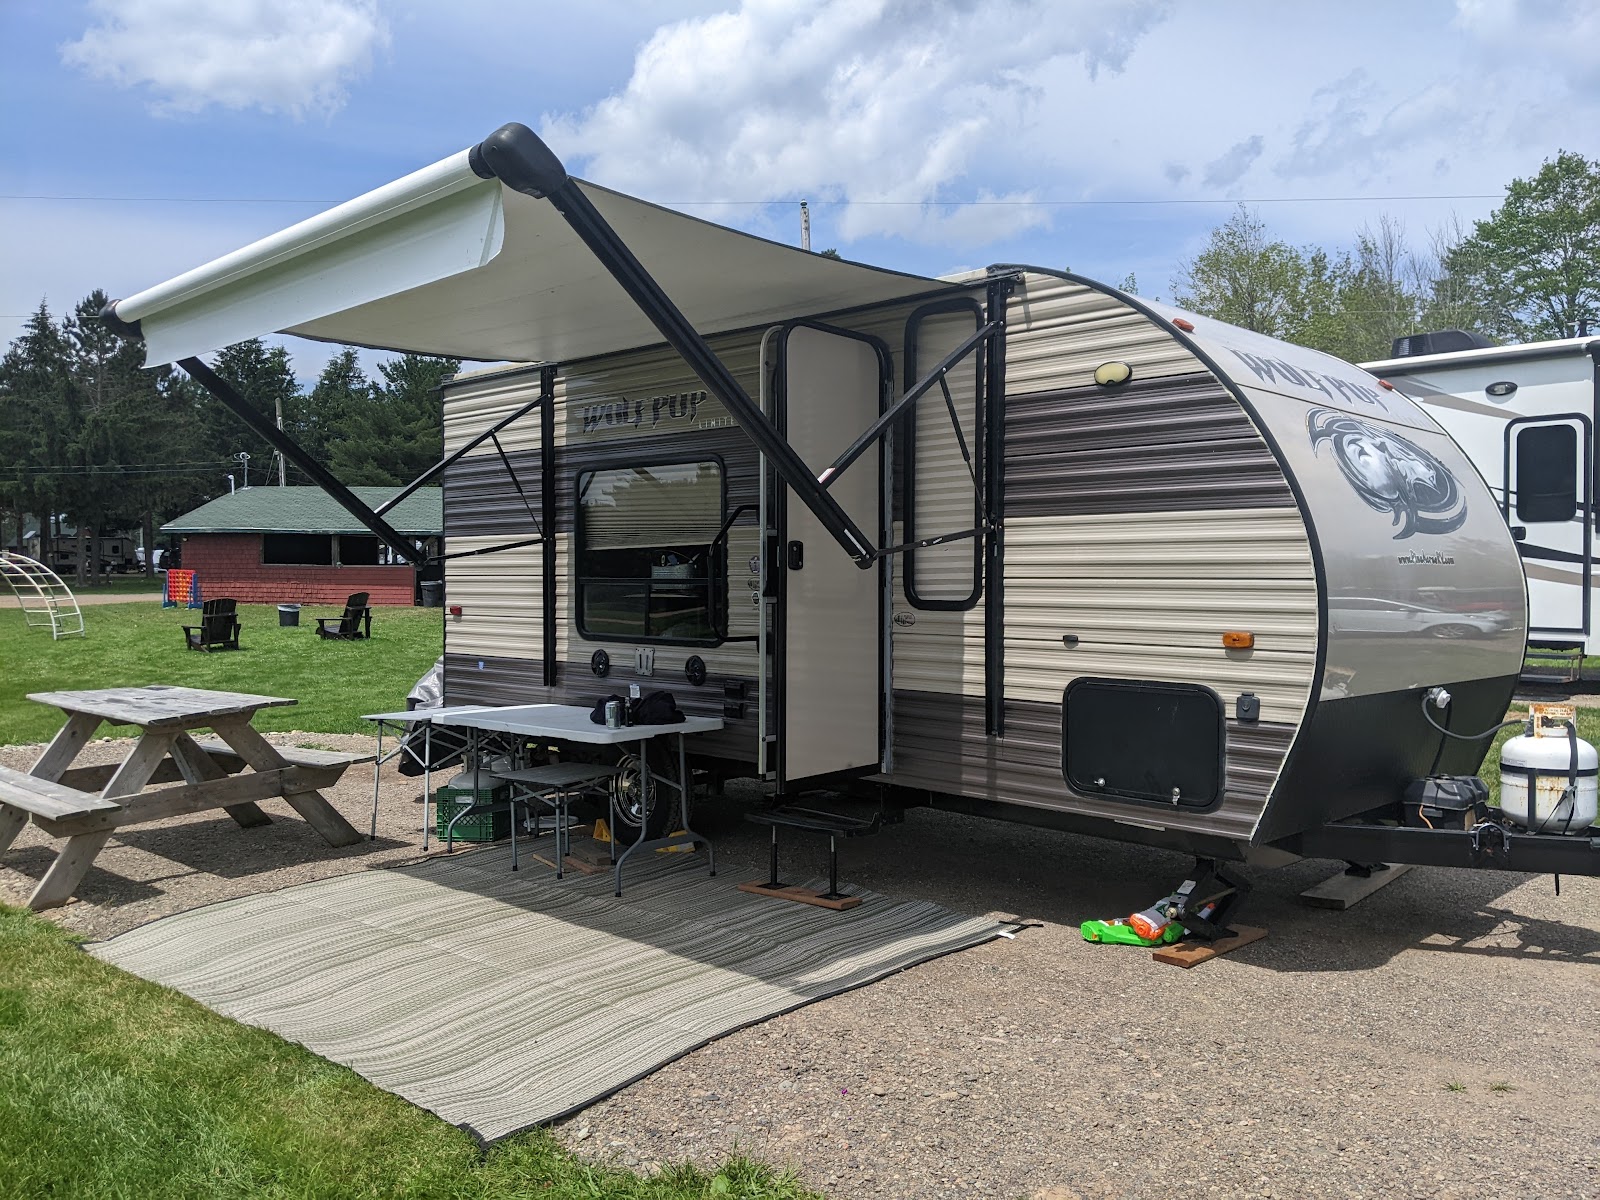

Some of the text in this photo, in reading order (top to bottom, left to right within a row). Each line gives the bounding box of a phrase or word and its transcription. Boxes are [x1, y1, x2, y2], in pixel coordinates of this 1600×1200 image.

[1223, 346, 1390, 414] WOLF PUP
[582, 390, 707, 434] WOLF PUP
[698, 416, 735, 429] LIMITE
